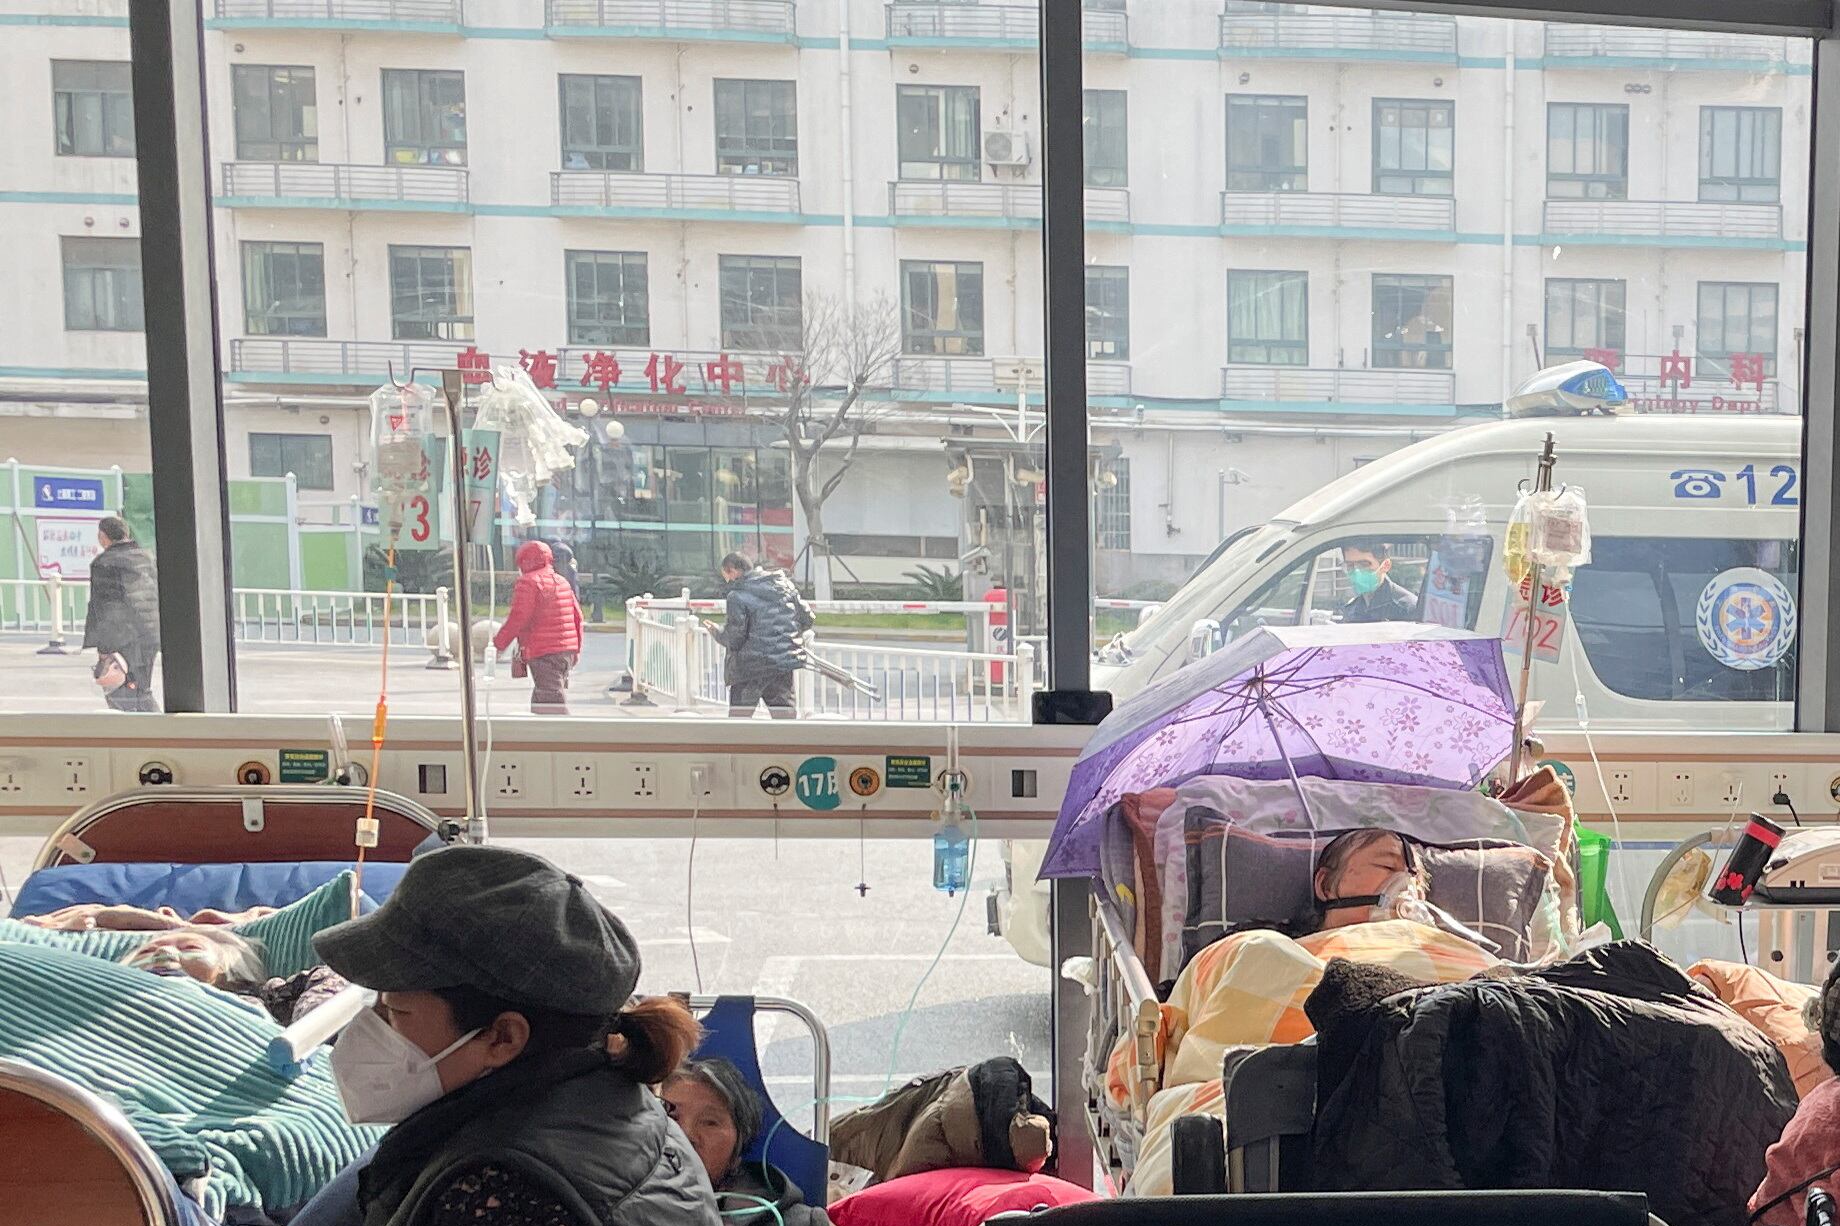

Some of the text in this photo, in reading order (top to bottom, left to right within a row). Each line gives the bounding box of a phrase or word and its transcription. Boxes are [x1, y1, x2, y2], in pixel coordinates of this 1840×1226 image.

[457, 346, 811, 394] 血液净化中心
[400, 495, 430, 542] 3
